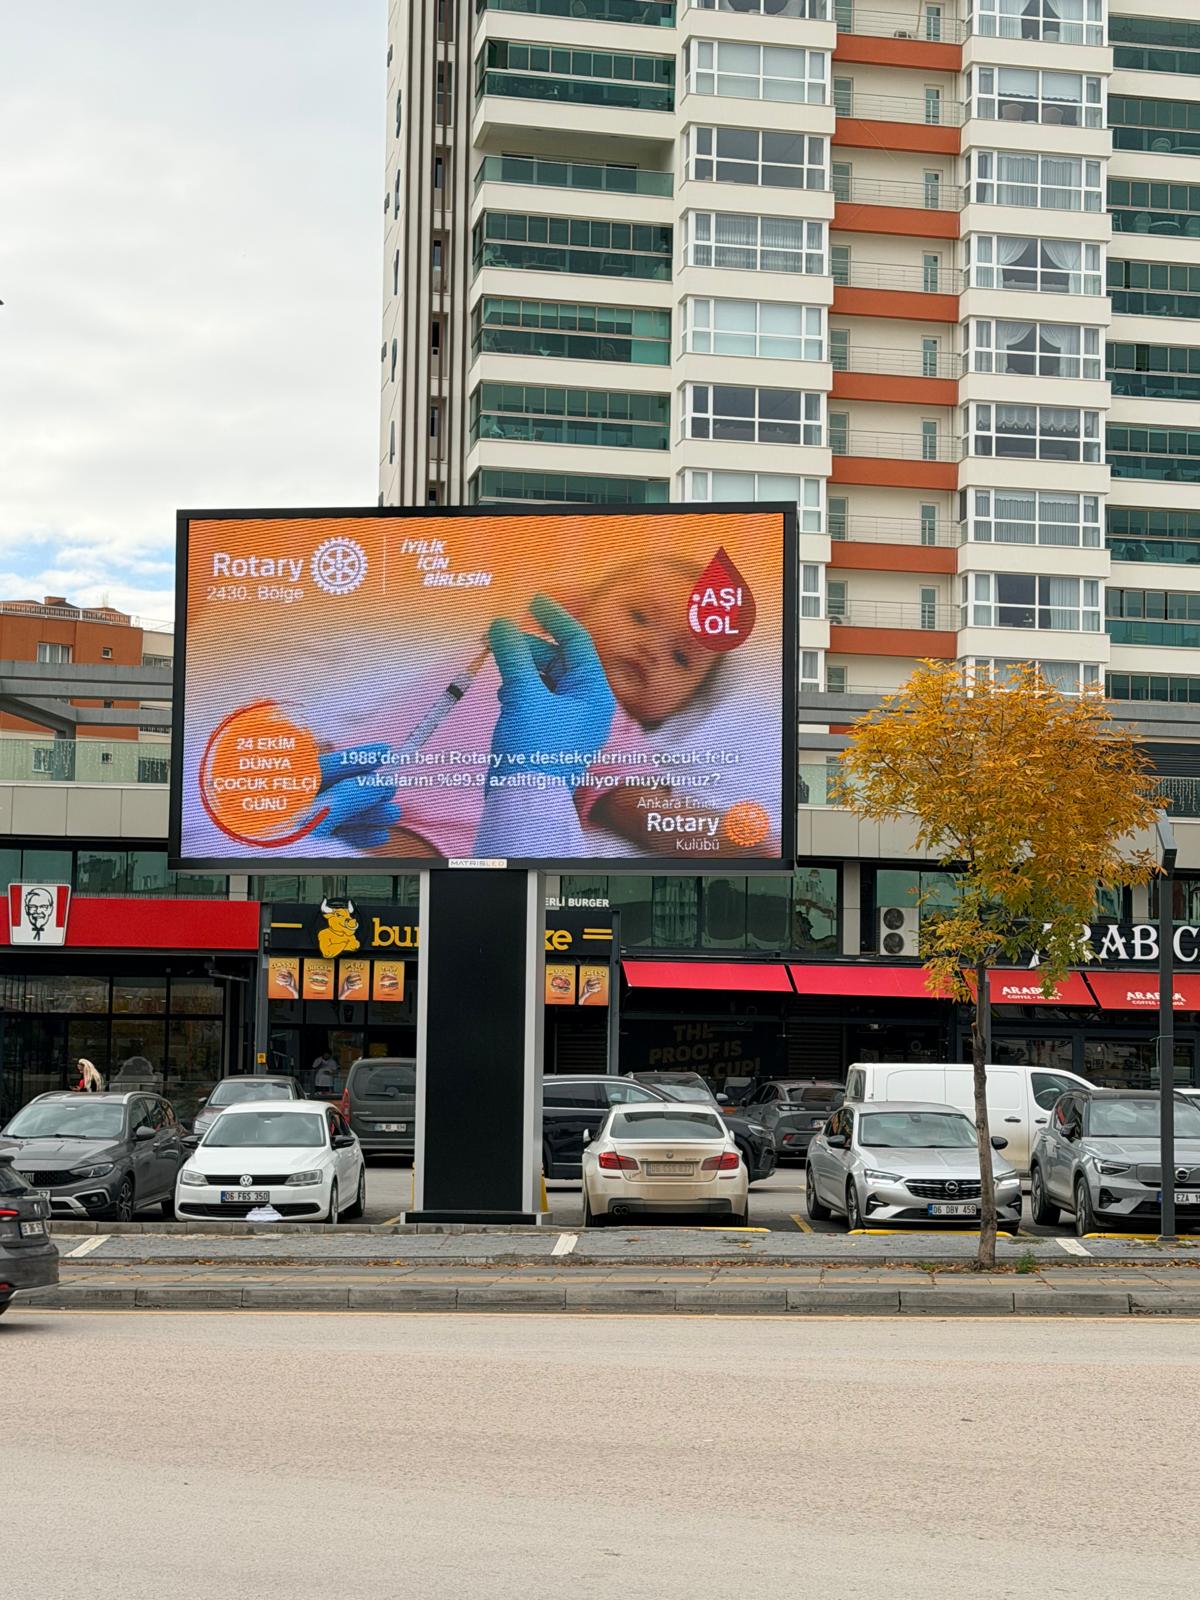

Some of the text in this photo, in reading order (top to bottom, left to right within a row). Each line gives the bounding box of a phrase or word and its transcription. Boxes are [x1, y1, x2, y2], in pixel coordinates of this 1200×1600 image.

[213, 552, 303, 581] Rotary
[704, 615, 739, 634] OL
[236, 736, 295, 750] 24 EKİM
[239, 755, 291, 769] DÜNYA
[340, 751, 411, 765] 1988'den
[450, 751, 503, 767] Rotary
[507, 753, 525, 764] ve
[213, 777, 269, 792] ÇOCUK
[571, 773, 620, 789] biliyor
[637, 797, 681, 808] Ankara
[647, 813, 719, 835] Rotary
[676, 838, 719, 850] Kulübü
[568, 898, 610, 908] BURGER
[649, 1040, 742, 1064] PROOF IS
[713, 1057, 760, 1079] CUP!
[225, 1192, 234, 1200] 06
[254, 1192, 268, 1200] 350
[933, 1205, 942, 1214] 06
